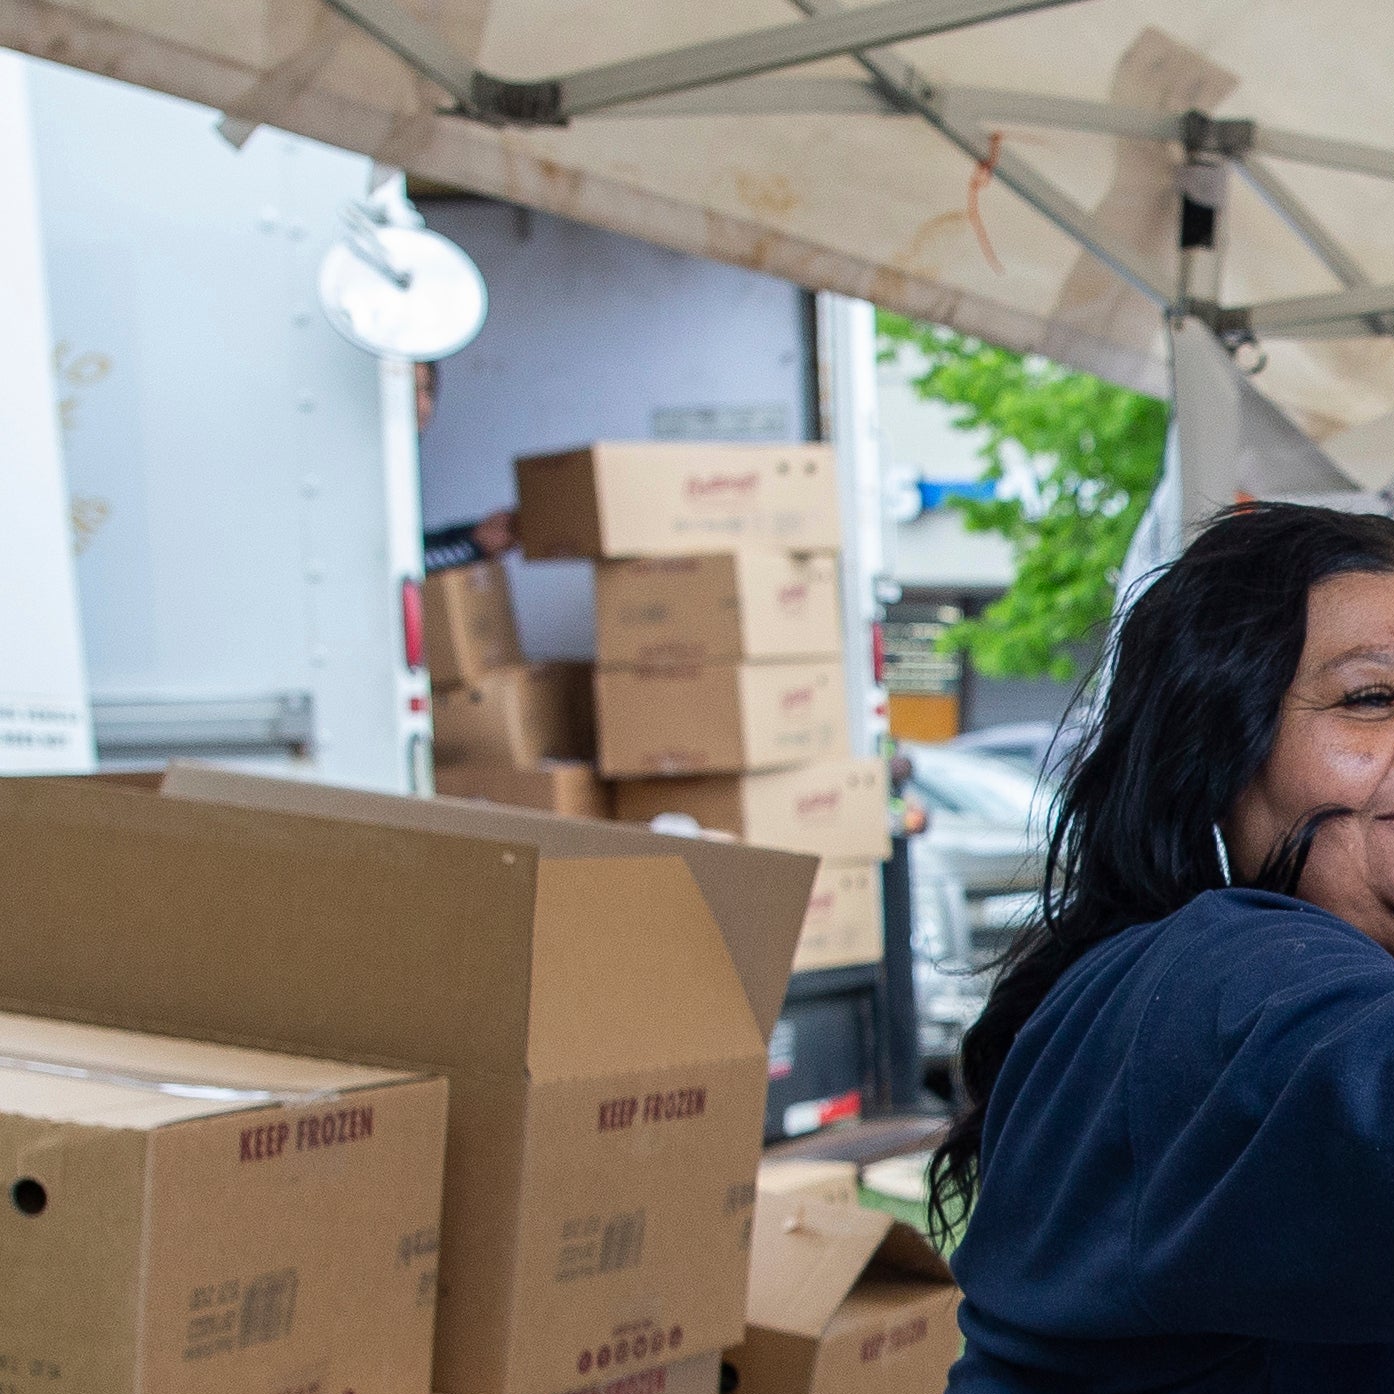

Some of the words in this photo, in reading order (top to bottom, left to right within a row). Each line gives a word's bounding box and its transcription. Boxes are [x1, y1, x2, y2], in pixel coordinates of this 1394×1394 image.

[239, 1123, 289, 1163] KEEP
[296, 1106, 374, 1149] FROZEN
[598, 1096, 638, 1133] KEEP
[643, 1087, 706, 1122] FROZEN
